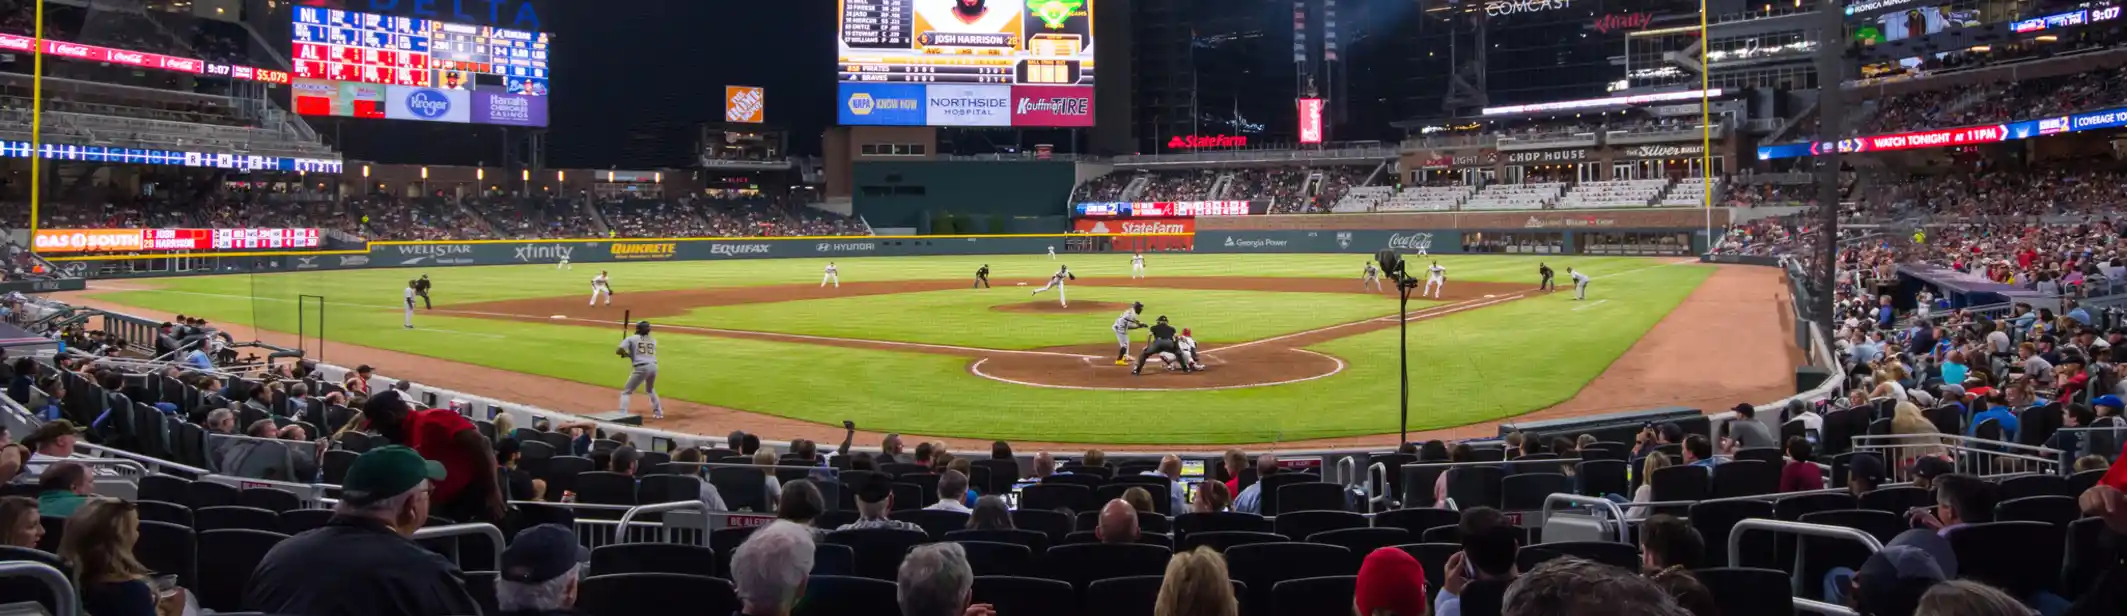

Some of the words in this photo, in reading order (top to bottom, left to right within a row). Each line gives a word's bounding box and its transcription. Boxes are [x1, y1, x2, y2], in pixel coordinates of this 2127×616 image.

[1854, 1, 1882, 13] KONICA
[301, 8, 319, 23] NL
[2092, 7, 2120, 21] 9:07
[935, 35, 956, 44] JOSH
[957, 36, 1003, 44] HARRISON
[301, 45, 319, 60] AL
[207, 64, 229, 75] 9:07
[257, 69, 287, 83] $5,079
[410, 93, 447, 116] Kroger
[852, 98, 871, 109] NAPA
[930, 98, 1007, 108] NORTHSIDE
[1017, 98, 1061, 114] Kauffman
[1052, 98, 1088, 114] TIRE
[2079, 114, 2114, 126] COVERAGE
[1874, 136, 1905, 147] WATCH
[1907, 133, 1951, 145] TONIGHT
[1967, 128, 1996, 141] 11PM
[1509, 152, 1541, 162] CHOP
[1544, 150, 1585, 161] HOUSE
[1638, 146, 1681, 157] Silver
[1452, 155, 1478, 165] LIGHT
[154, 230, 176, 239] JOSH
[36, 234, 70, 248] GAS
[86, 234, 140, 247] SOUTH
[154, 239, 195, 249] HARRISON
[833, 243, 875, 251] HYUNDAI
[1236, 239, 1263, 248] Georgia
[1265, 238, 1287, 246] Power
[398, 244, 472, 256] WELLSTAR
[514, 243, 574, 261] xfinity
[610, 243, 677, 255] QUIKRETE
[710, 244, 771, 256] EQUIFAX
